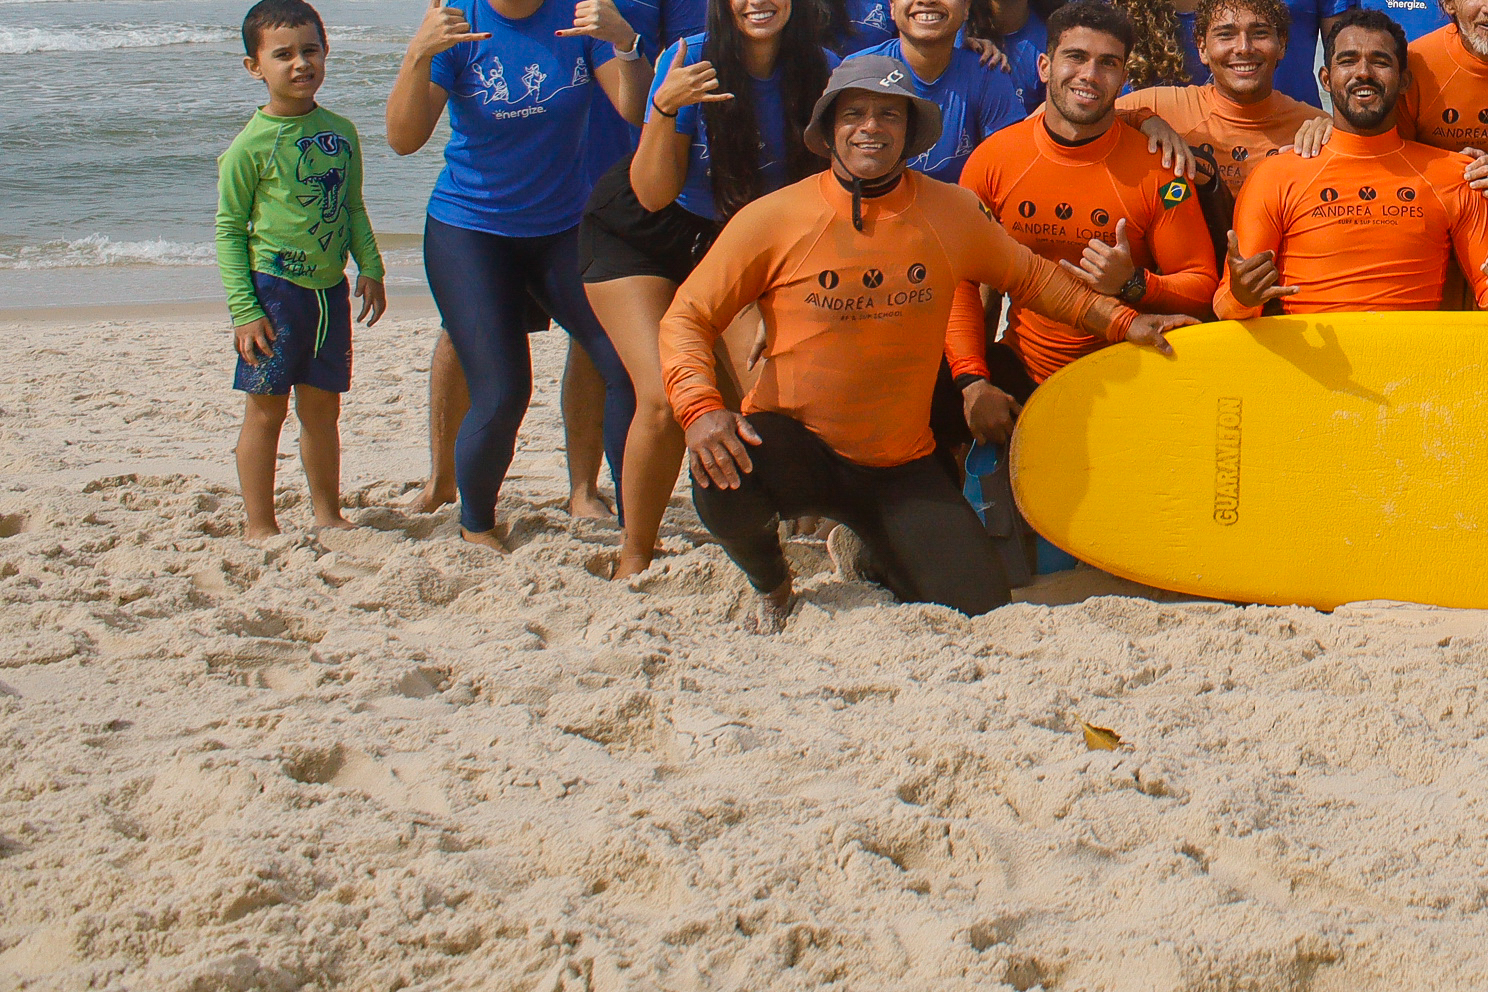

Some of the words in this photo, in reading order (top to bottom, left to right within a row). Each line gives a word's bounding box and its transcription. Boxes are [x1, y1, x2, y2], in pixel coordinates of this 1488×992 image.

[493, 106, 547, 119] energize.
[1432, 127, 1488, 139] ANDREA
[1311, 205, 1372, 218] ANDREA
[1381, 205, 1424, 218] LOPES
[1012, 221, 1067, 236] ANDREA
[804, 292, 874, 311] ANDREA
[887, 287, 933, 306] LOPES
